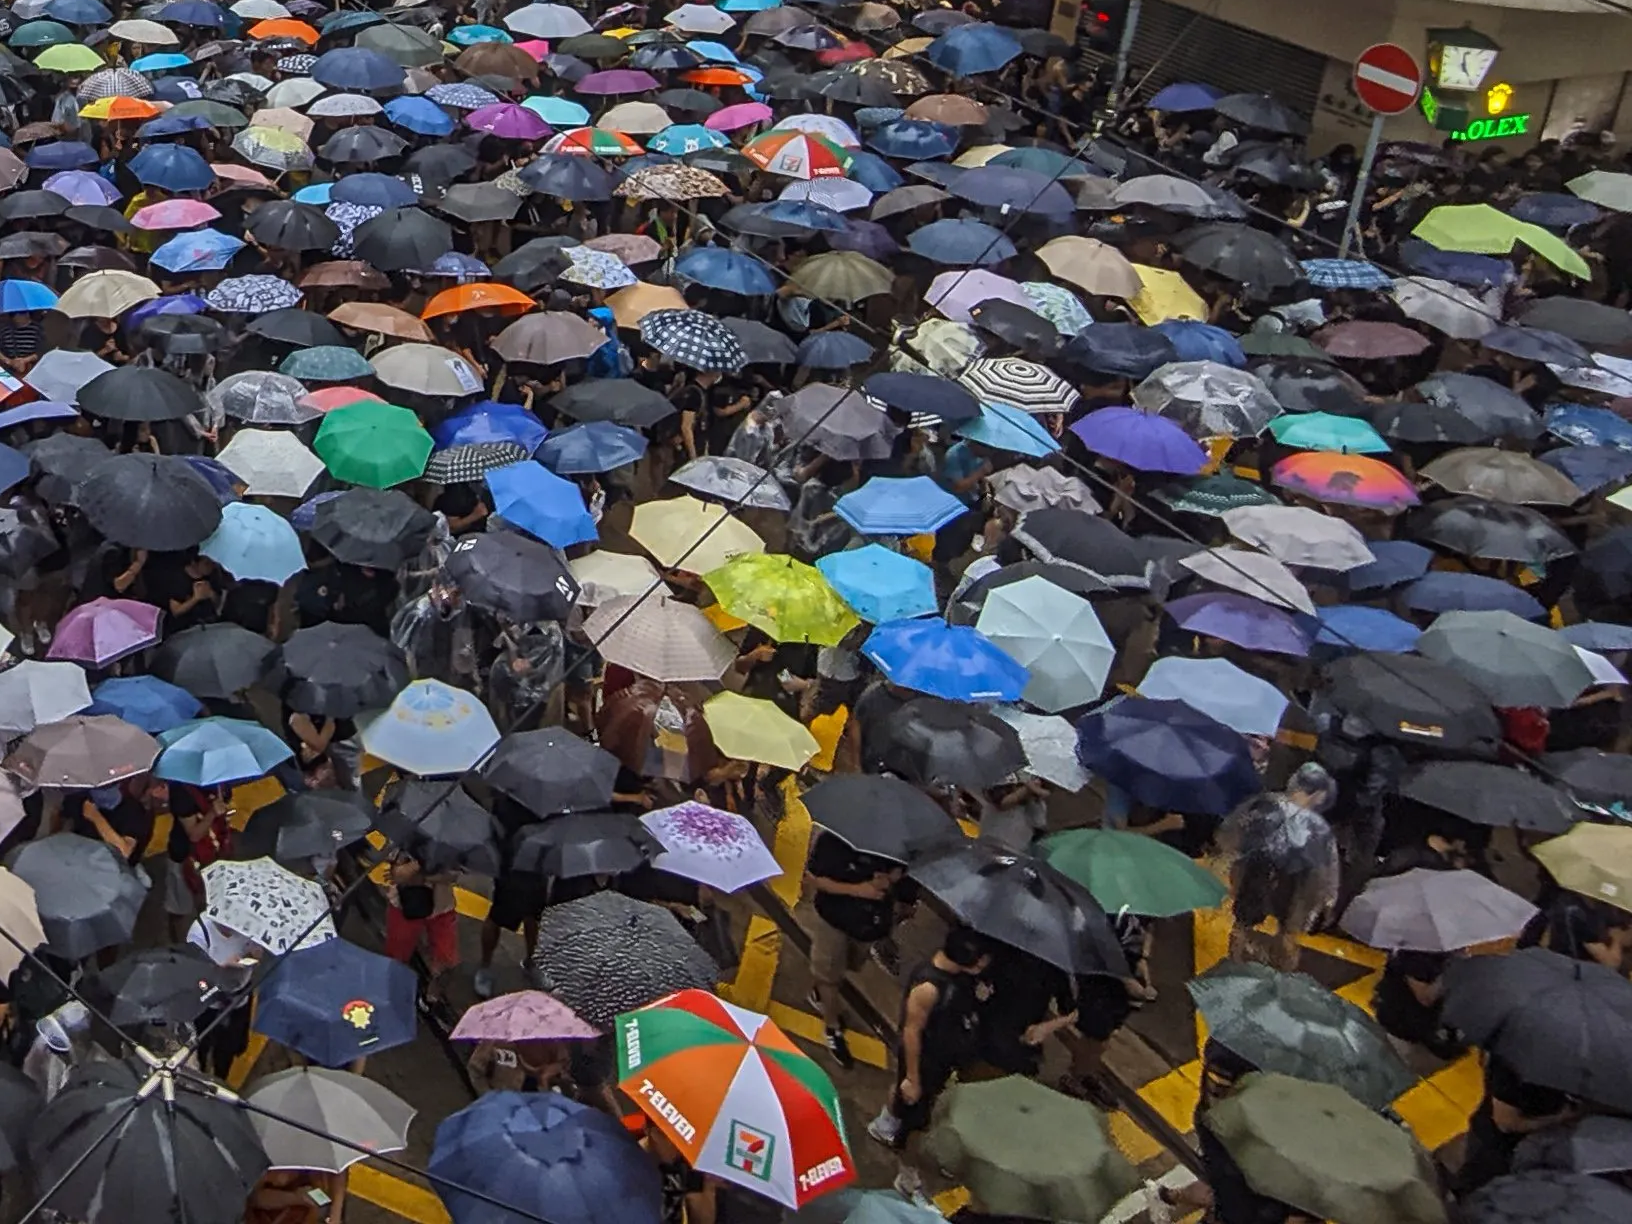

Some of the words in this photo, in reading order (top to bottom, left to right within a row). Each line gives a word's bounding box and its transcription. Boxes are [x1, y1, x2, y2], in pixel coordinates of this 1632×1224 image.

[1449, 113, 1531, 142] OLEX
[624, 1017, 641, 1070] 7-ELEVEN
[639, 1078, 697, 1144] 7-ELEVEN
